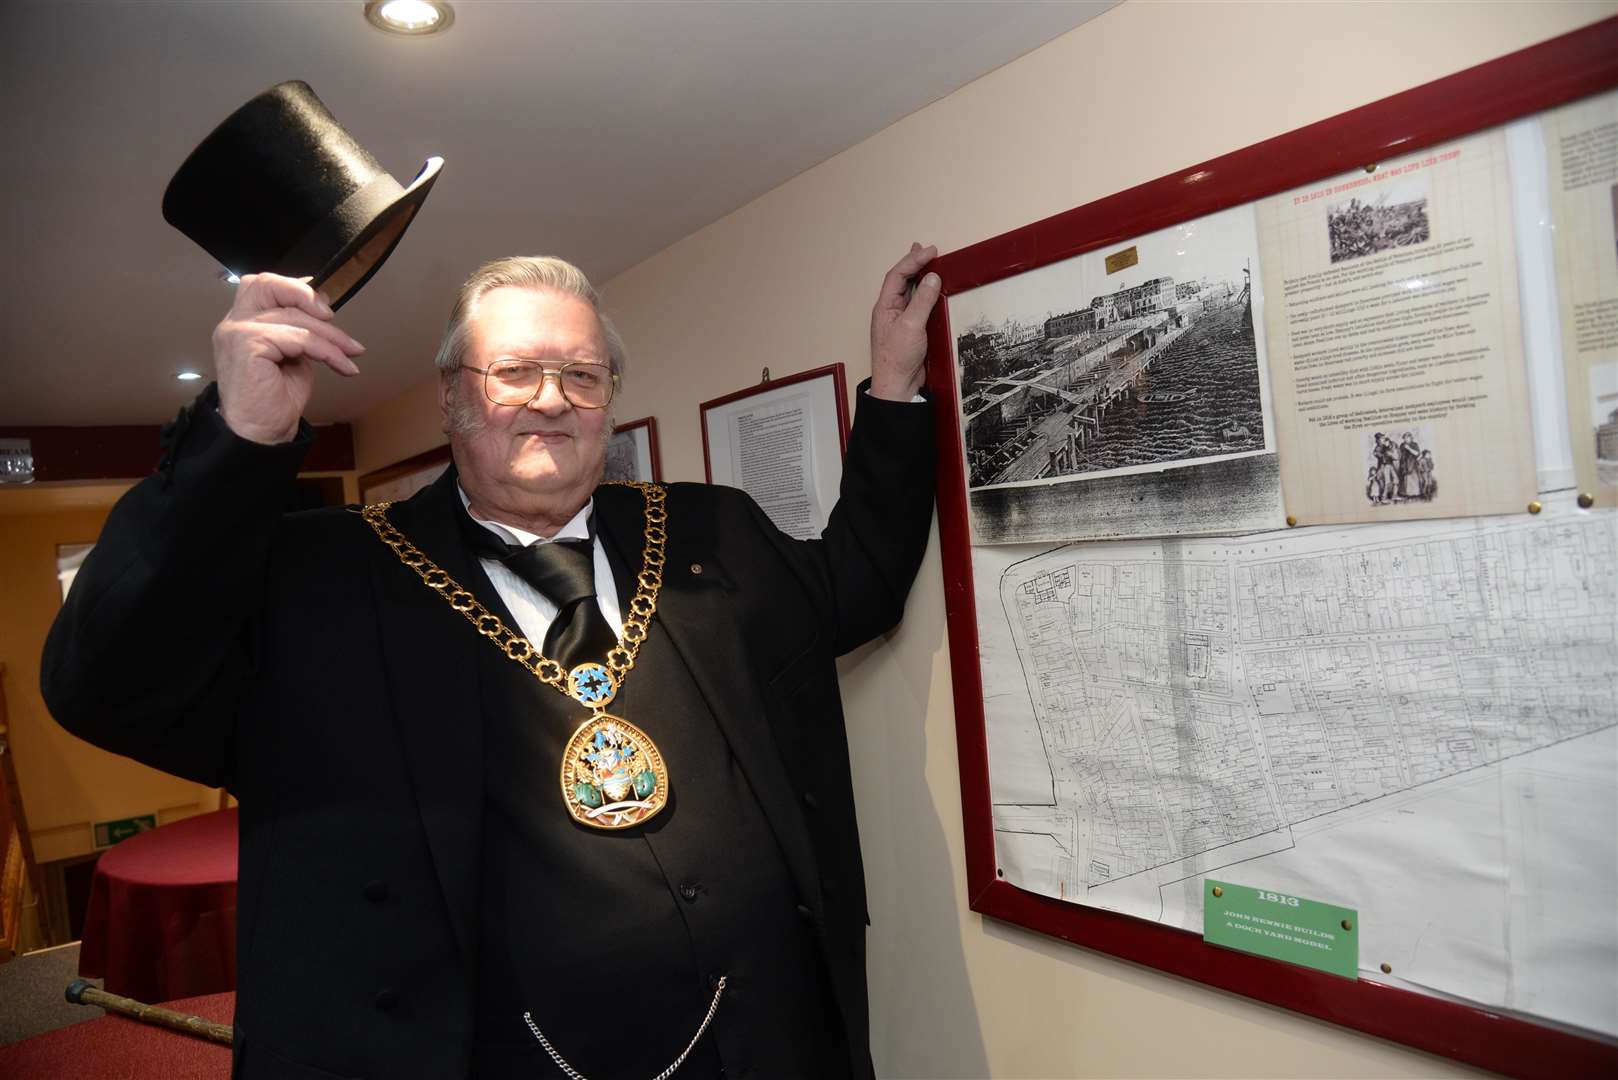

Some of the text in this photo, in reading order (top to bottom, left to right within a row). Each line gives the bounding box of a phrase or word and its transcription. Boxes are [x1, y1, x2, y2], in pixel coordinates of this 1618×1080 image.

[1258, 891, 1300, 907] 1813
[1224, 910, 1335, 940] JOHN RENNIE BUILDS
[1234, 923, 1262, 934] DOCK
[1264, 930, 1292, 942] YARD
